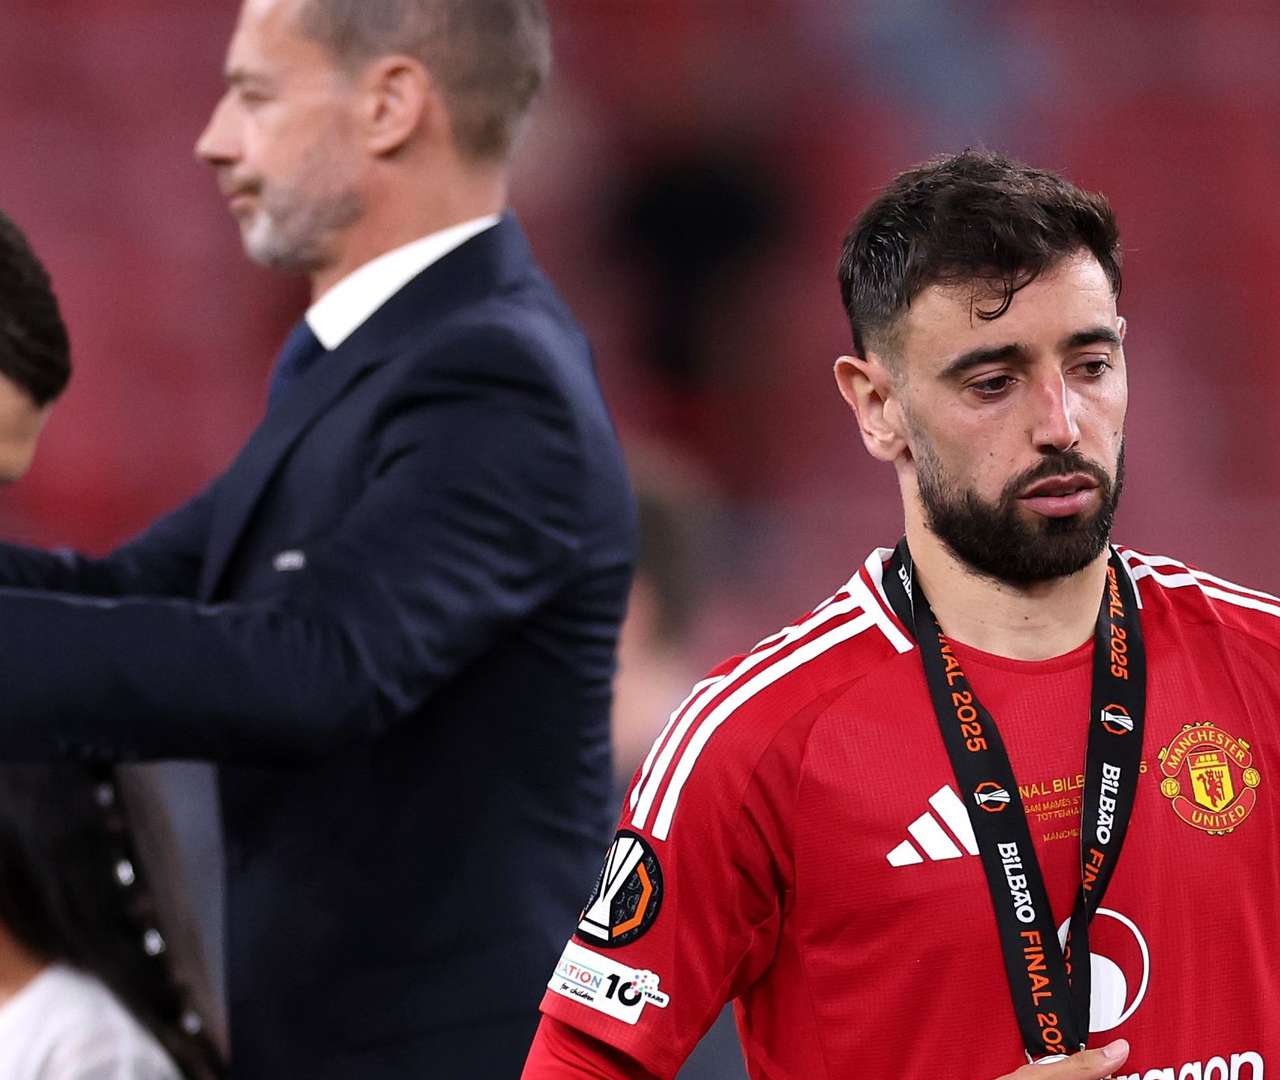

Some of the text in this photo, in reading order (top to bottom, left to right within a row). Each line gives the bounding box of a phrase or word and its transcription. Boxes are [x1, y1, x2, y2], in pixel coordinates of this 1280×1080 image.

[1110, 629, 1128, 680] 2025
[952, 690, 988, 752] 2025
[1167, 730, 1245, 769] MANCHESTER
[1018, 774, 1085, 800] NAL BILB
[1036, 806, 1080, 822] TOTTENHA
[1191, 804, 1245, 827] UNITED
[1084, 848, 1105, 891] FIN
[606, 974, 643, 1007] 10
[644, 991, 664, 1003] YEARS
[1020, 931, 1052, 1007] FINAL
[1036, 1012, 1066, 1054] 20
